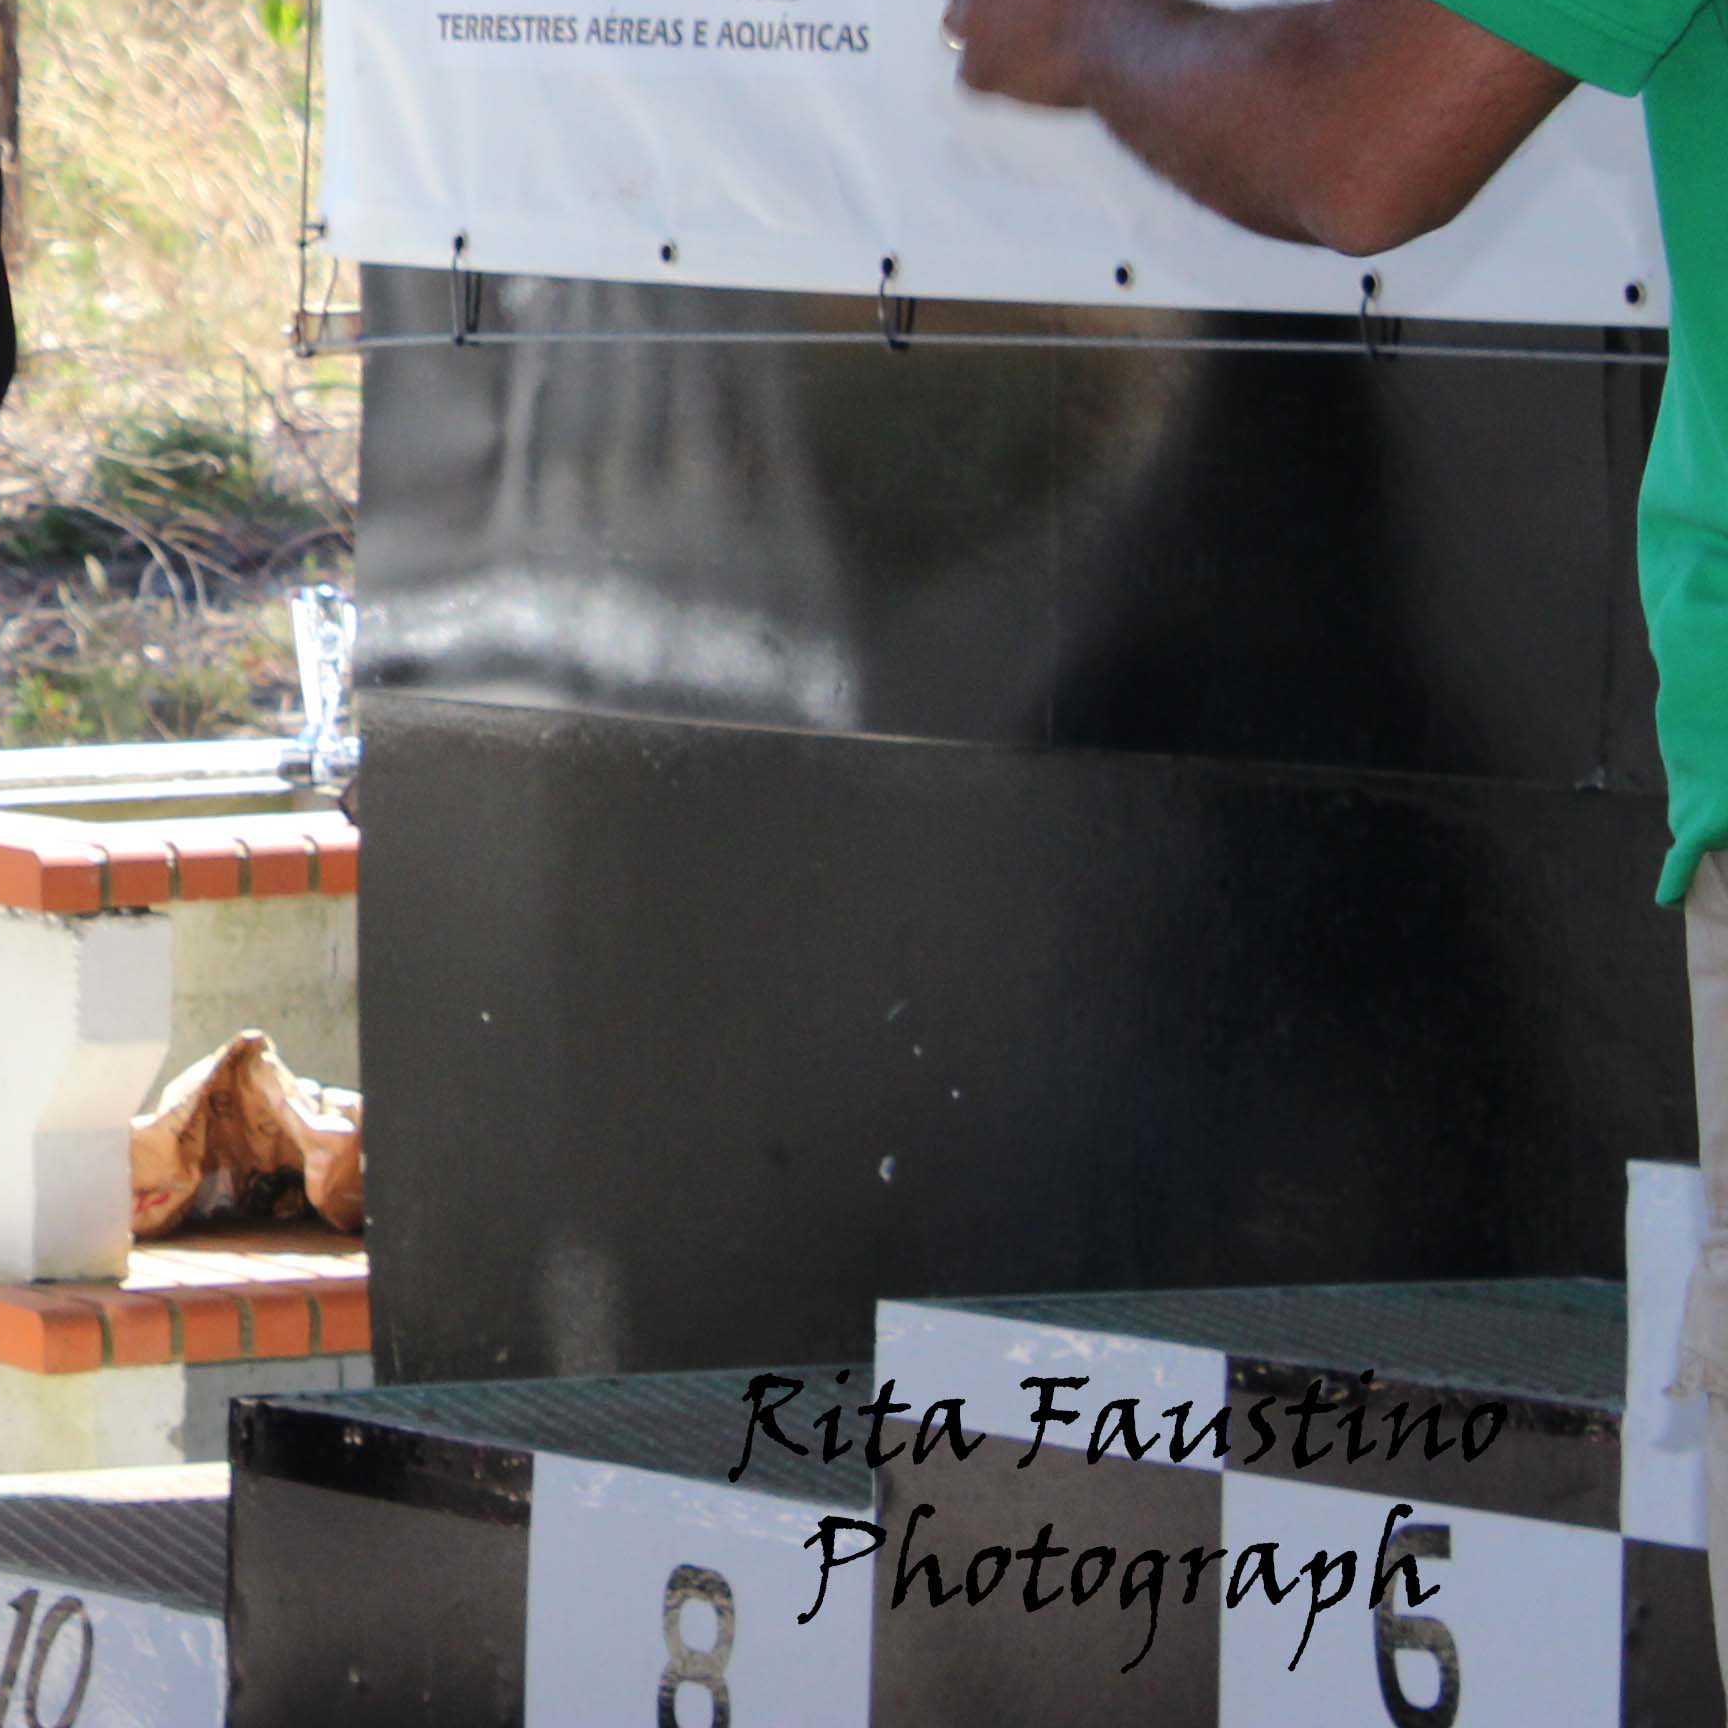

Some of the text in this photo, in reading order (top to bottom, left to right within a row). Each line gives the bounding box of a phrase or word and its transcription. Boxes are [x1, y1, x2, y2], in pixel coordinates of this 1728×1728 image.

[437, 8, 871, 54] TERRESTRES AÉREAS E AQUÁTICAS
[656, 1563, 737, 1728] 8
[1373, 1524, 1462, 1728] 6
